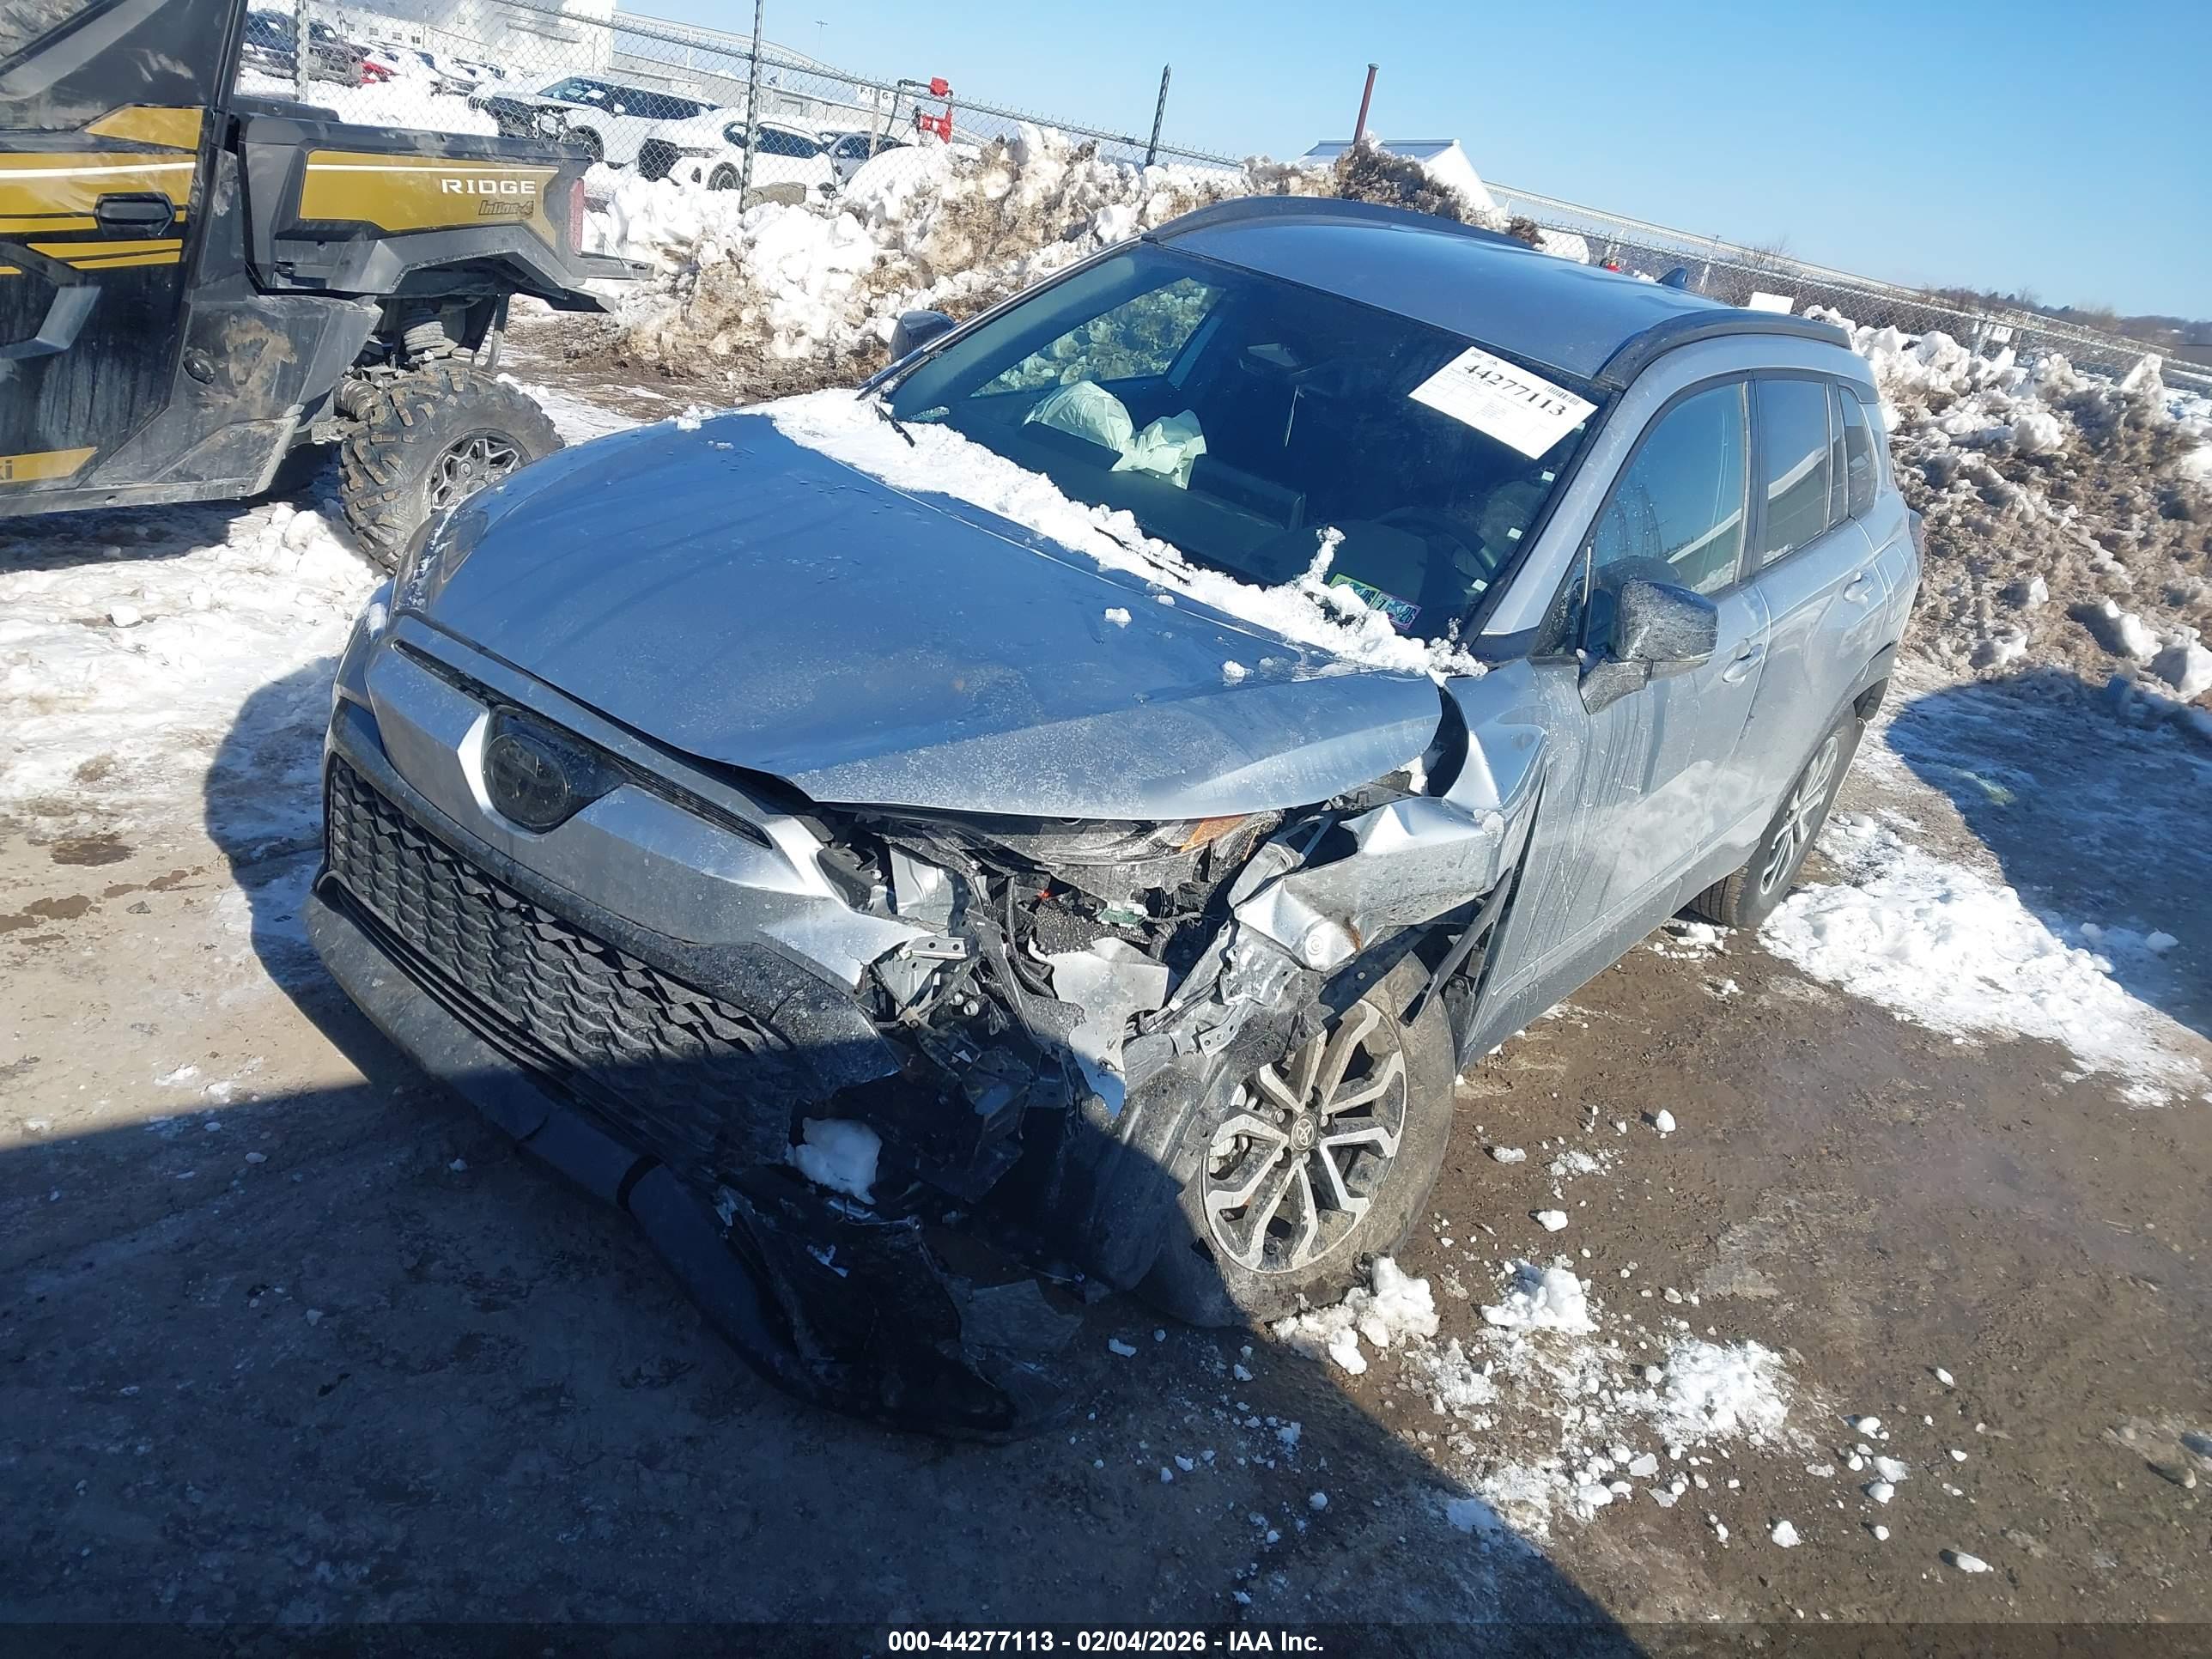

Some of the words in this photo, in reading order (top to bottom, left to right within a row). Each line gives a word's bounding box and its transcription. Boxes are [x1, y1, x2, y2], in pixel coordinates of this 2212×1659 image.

[441, 179, 537, 194] RIDGE
[1464, 364, 1567, 416] 44277113
[1400, 606, 1417, 624] 26
